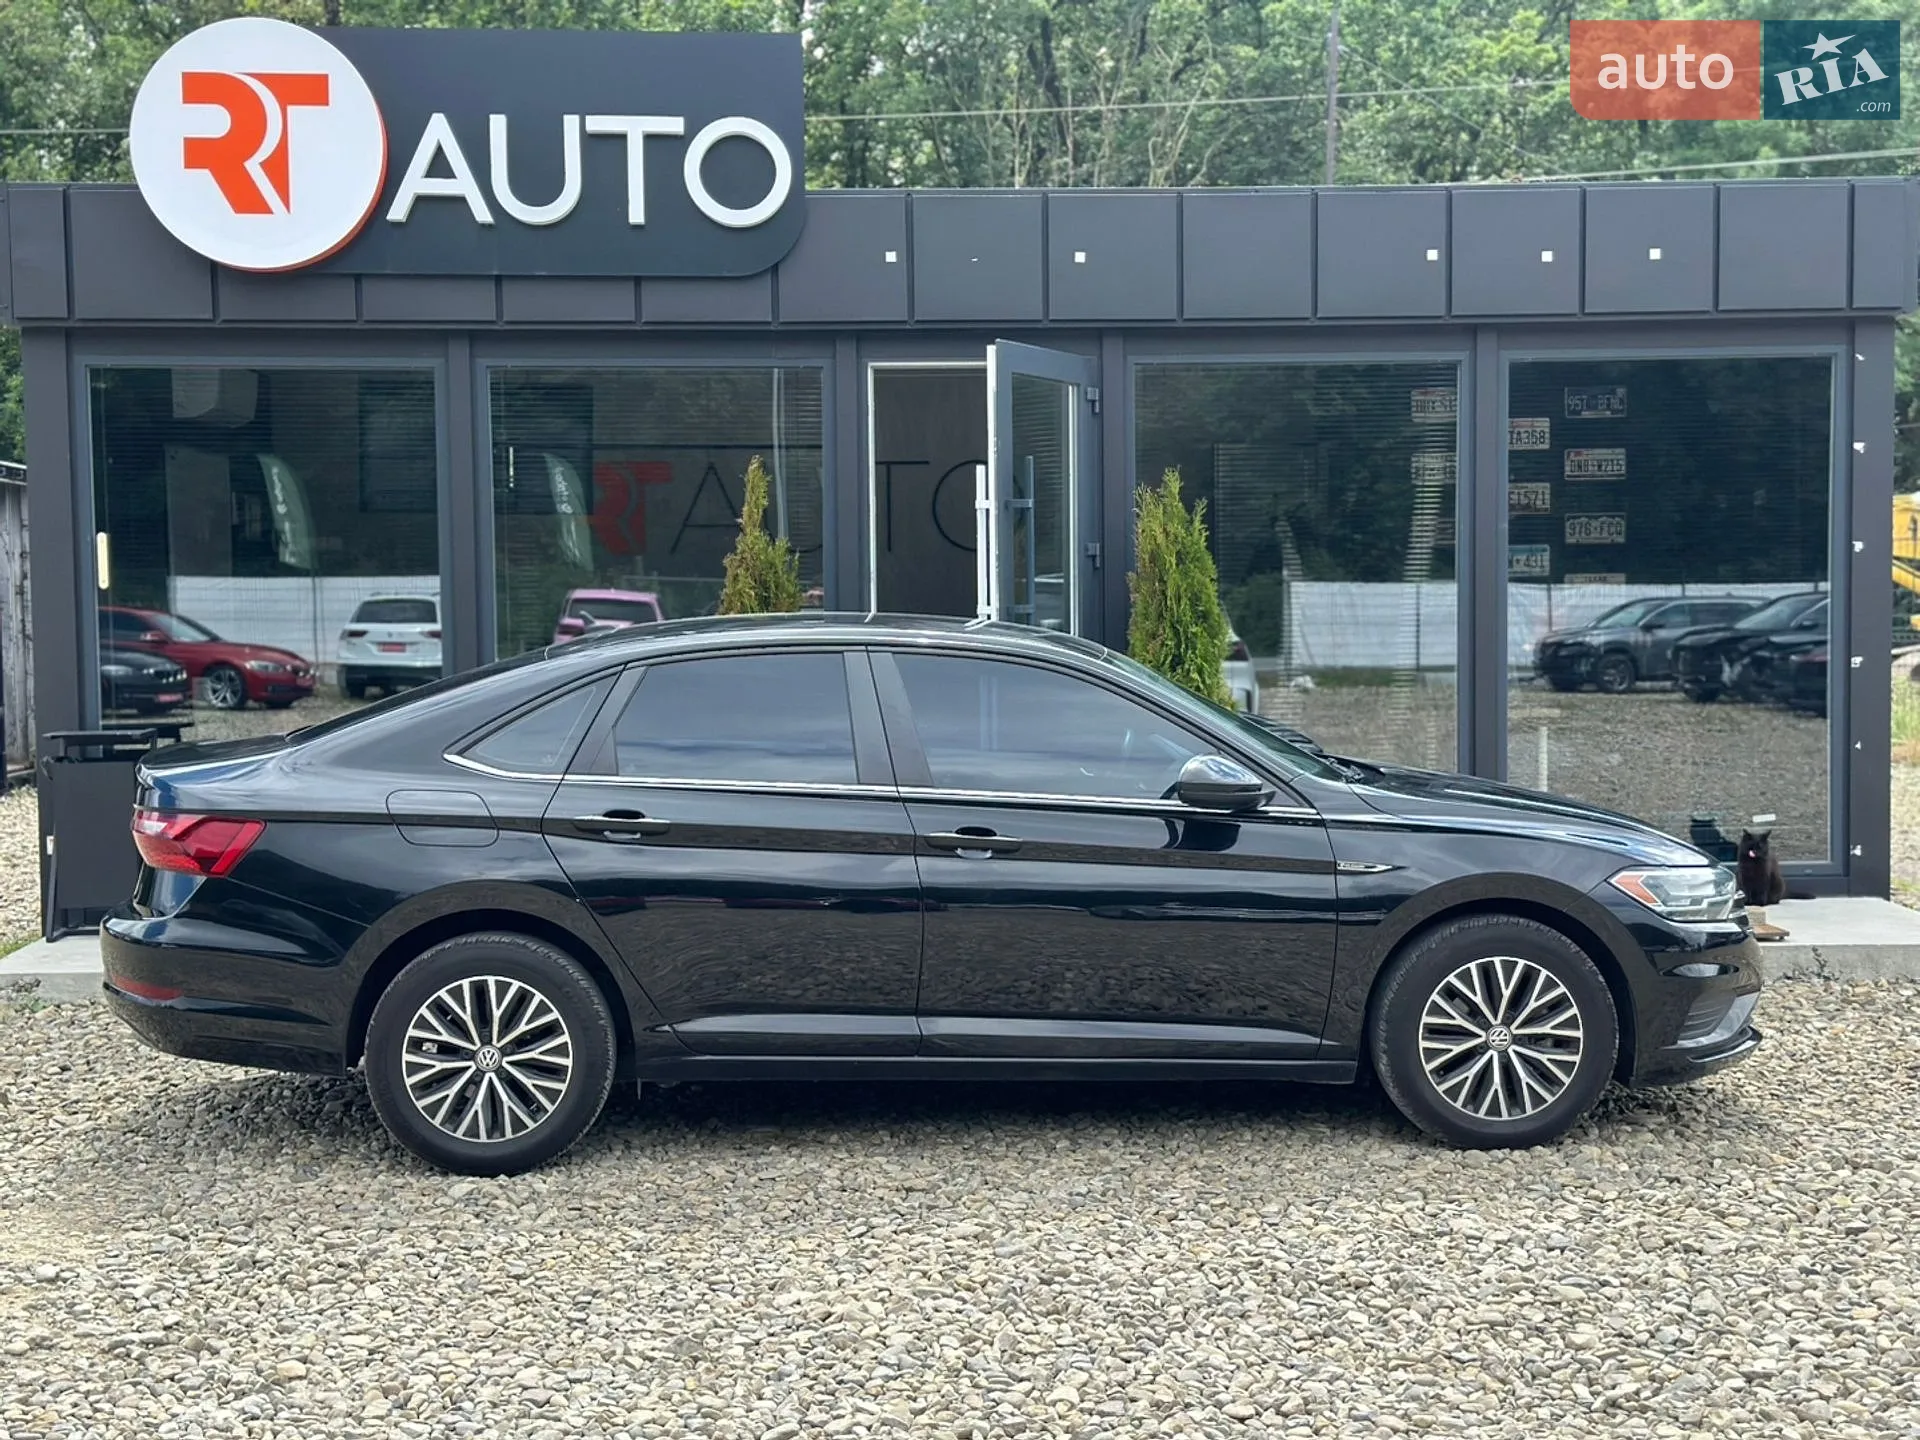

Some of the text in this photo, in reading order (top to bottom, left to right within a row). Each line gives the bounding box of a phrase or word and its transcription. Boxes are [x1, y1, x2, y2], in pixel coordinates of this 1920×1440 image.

[181, 71, 792, 228] RT AUTO
[669, 461, 1024, 553] ATO
